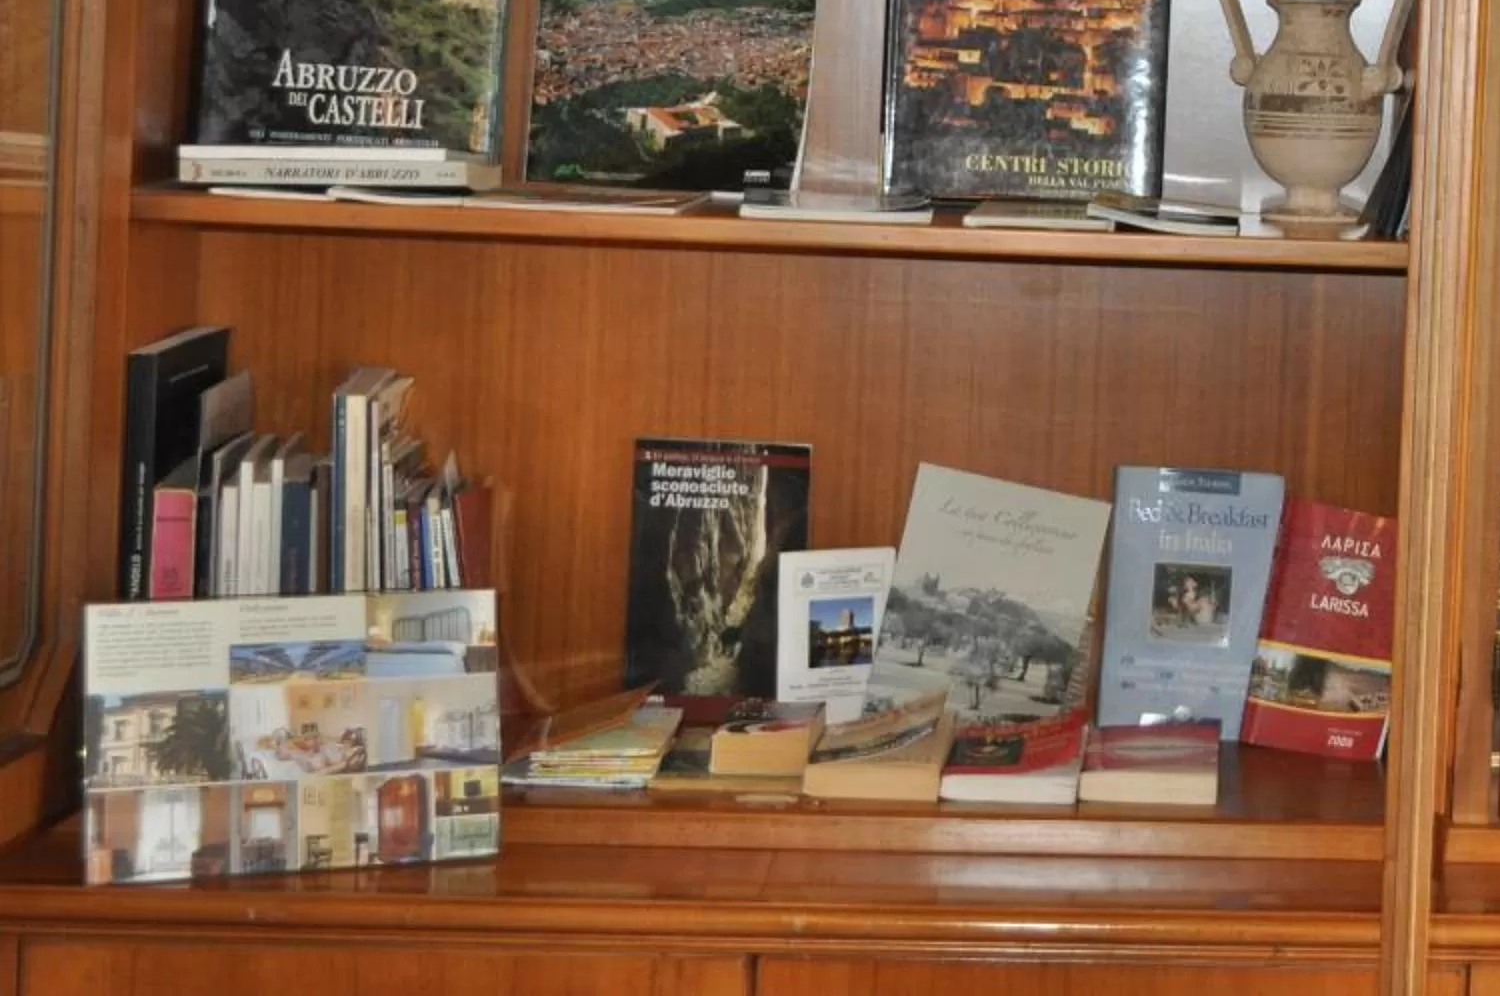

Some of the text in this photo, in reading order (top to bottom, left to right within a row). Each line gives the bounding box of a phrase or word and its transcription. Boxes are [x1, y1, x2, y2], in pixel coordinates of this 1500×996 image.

[272, 48, 418, 95] ABRUZZO
[308, 92, 426, 130] CASTELLI
[965, 154, 1047, 174] CENTRI
[652, 462, 737, 482] Meraviglie
[650, 479, 750, 495] sconosciute
[650, 493, 730, 509] d'Abruzzo
[1187, 501, 1269, 530] Breakfast
[1310, 592, 1369, 618] LARISSA
